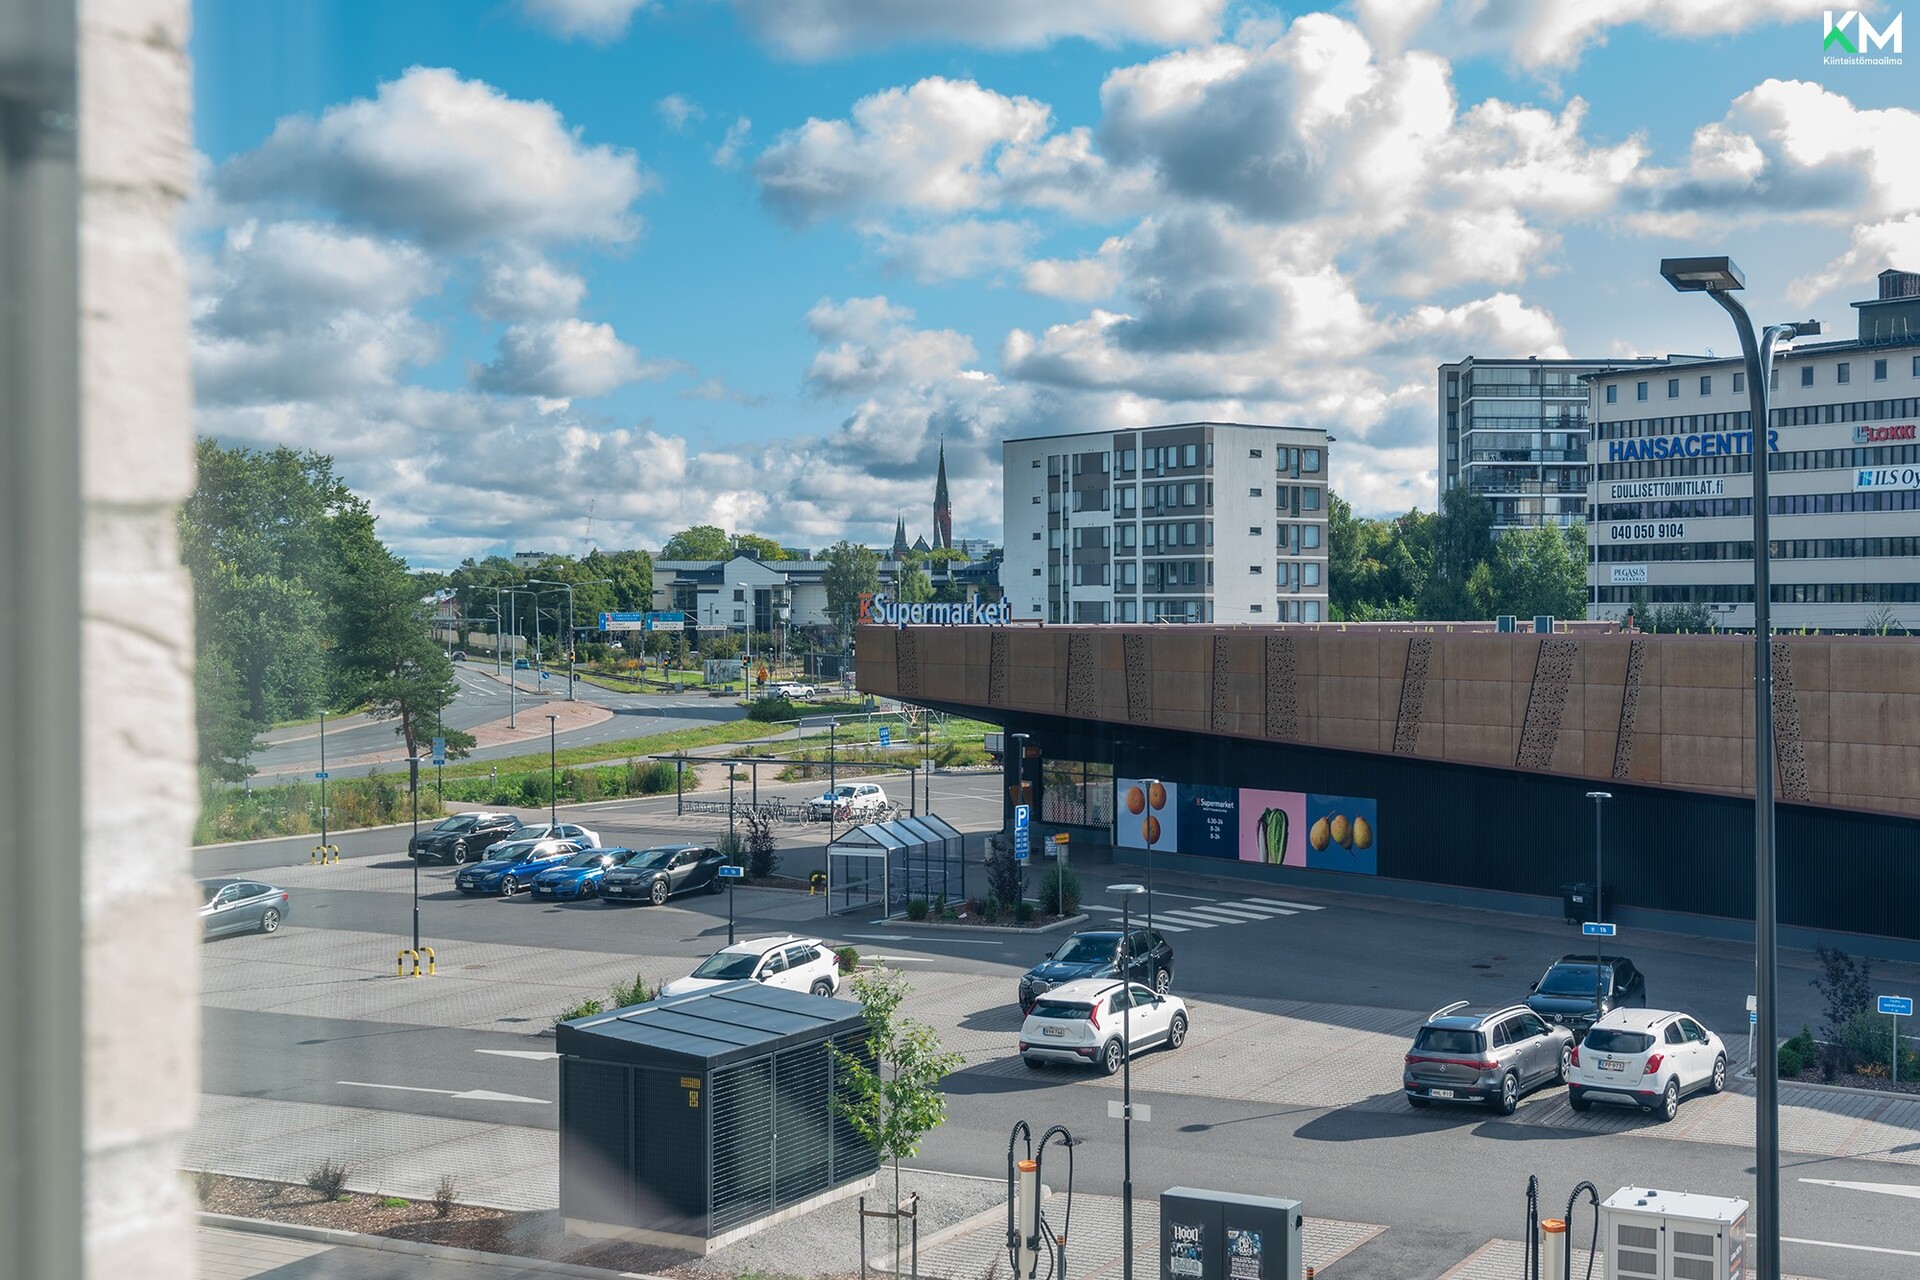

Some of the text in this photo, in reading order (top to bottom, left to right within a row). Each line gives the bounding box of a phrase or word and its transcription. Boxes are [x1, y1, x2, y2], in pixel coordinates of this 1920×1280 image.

[1875, 469, 1899, 485] ILS
[1611, 479, 1724, 499] EDULLISETTOIMITILAT.fi
[1611, 523, 1684, 540] 040 050 9104
[1614, 568, 1646, 578] PEGASUS
